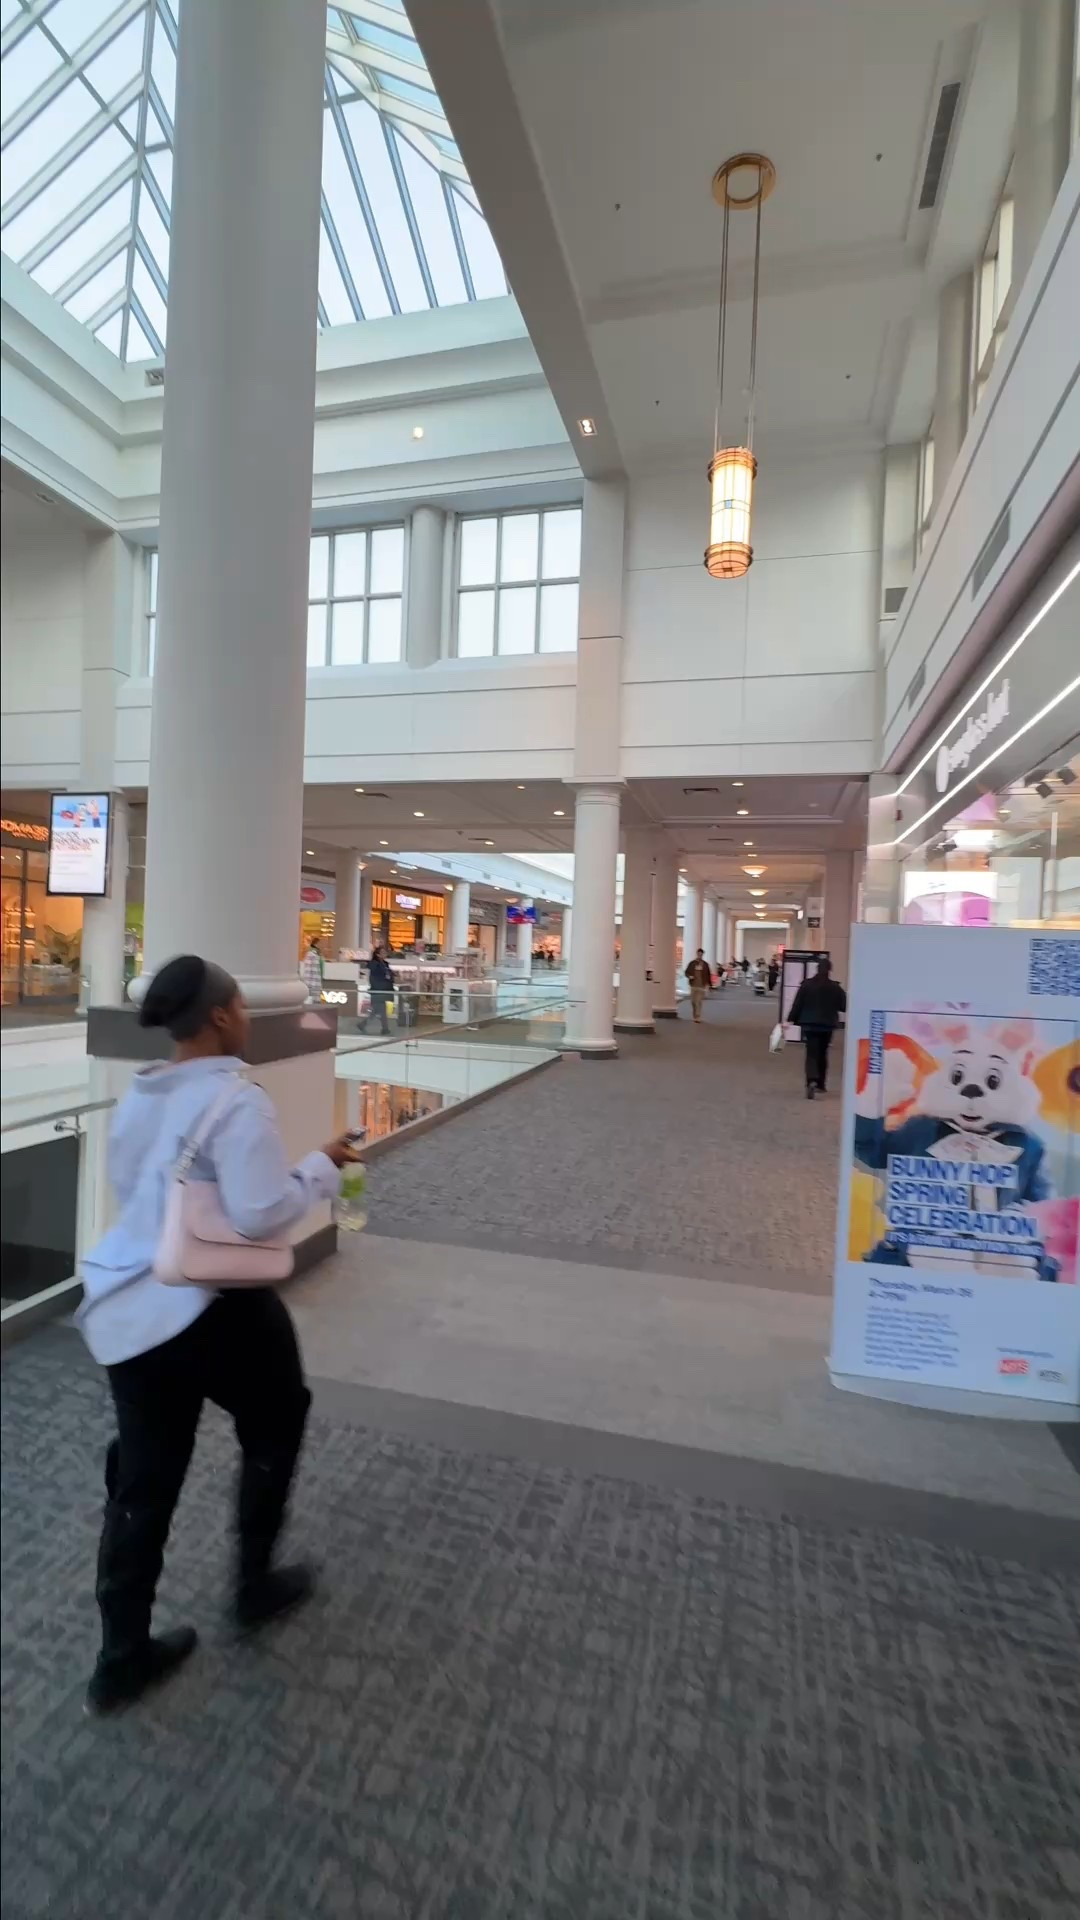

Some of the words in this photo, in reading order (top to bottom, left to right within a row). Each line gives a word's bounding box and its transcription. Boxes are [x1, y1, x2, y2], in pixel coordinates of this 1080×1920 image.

[891, 1157, 962, 1183] BUNNY
[970, 1163, 1014, 1187] HOP
[891, 1180, 968, 1206] SPRING
[889, 1205, 1035, 1238] CELEBRATION
